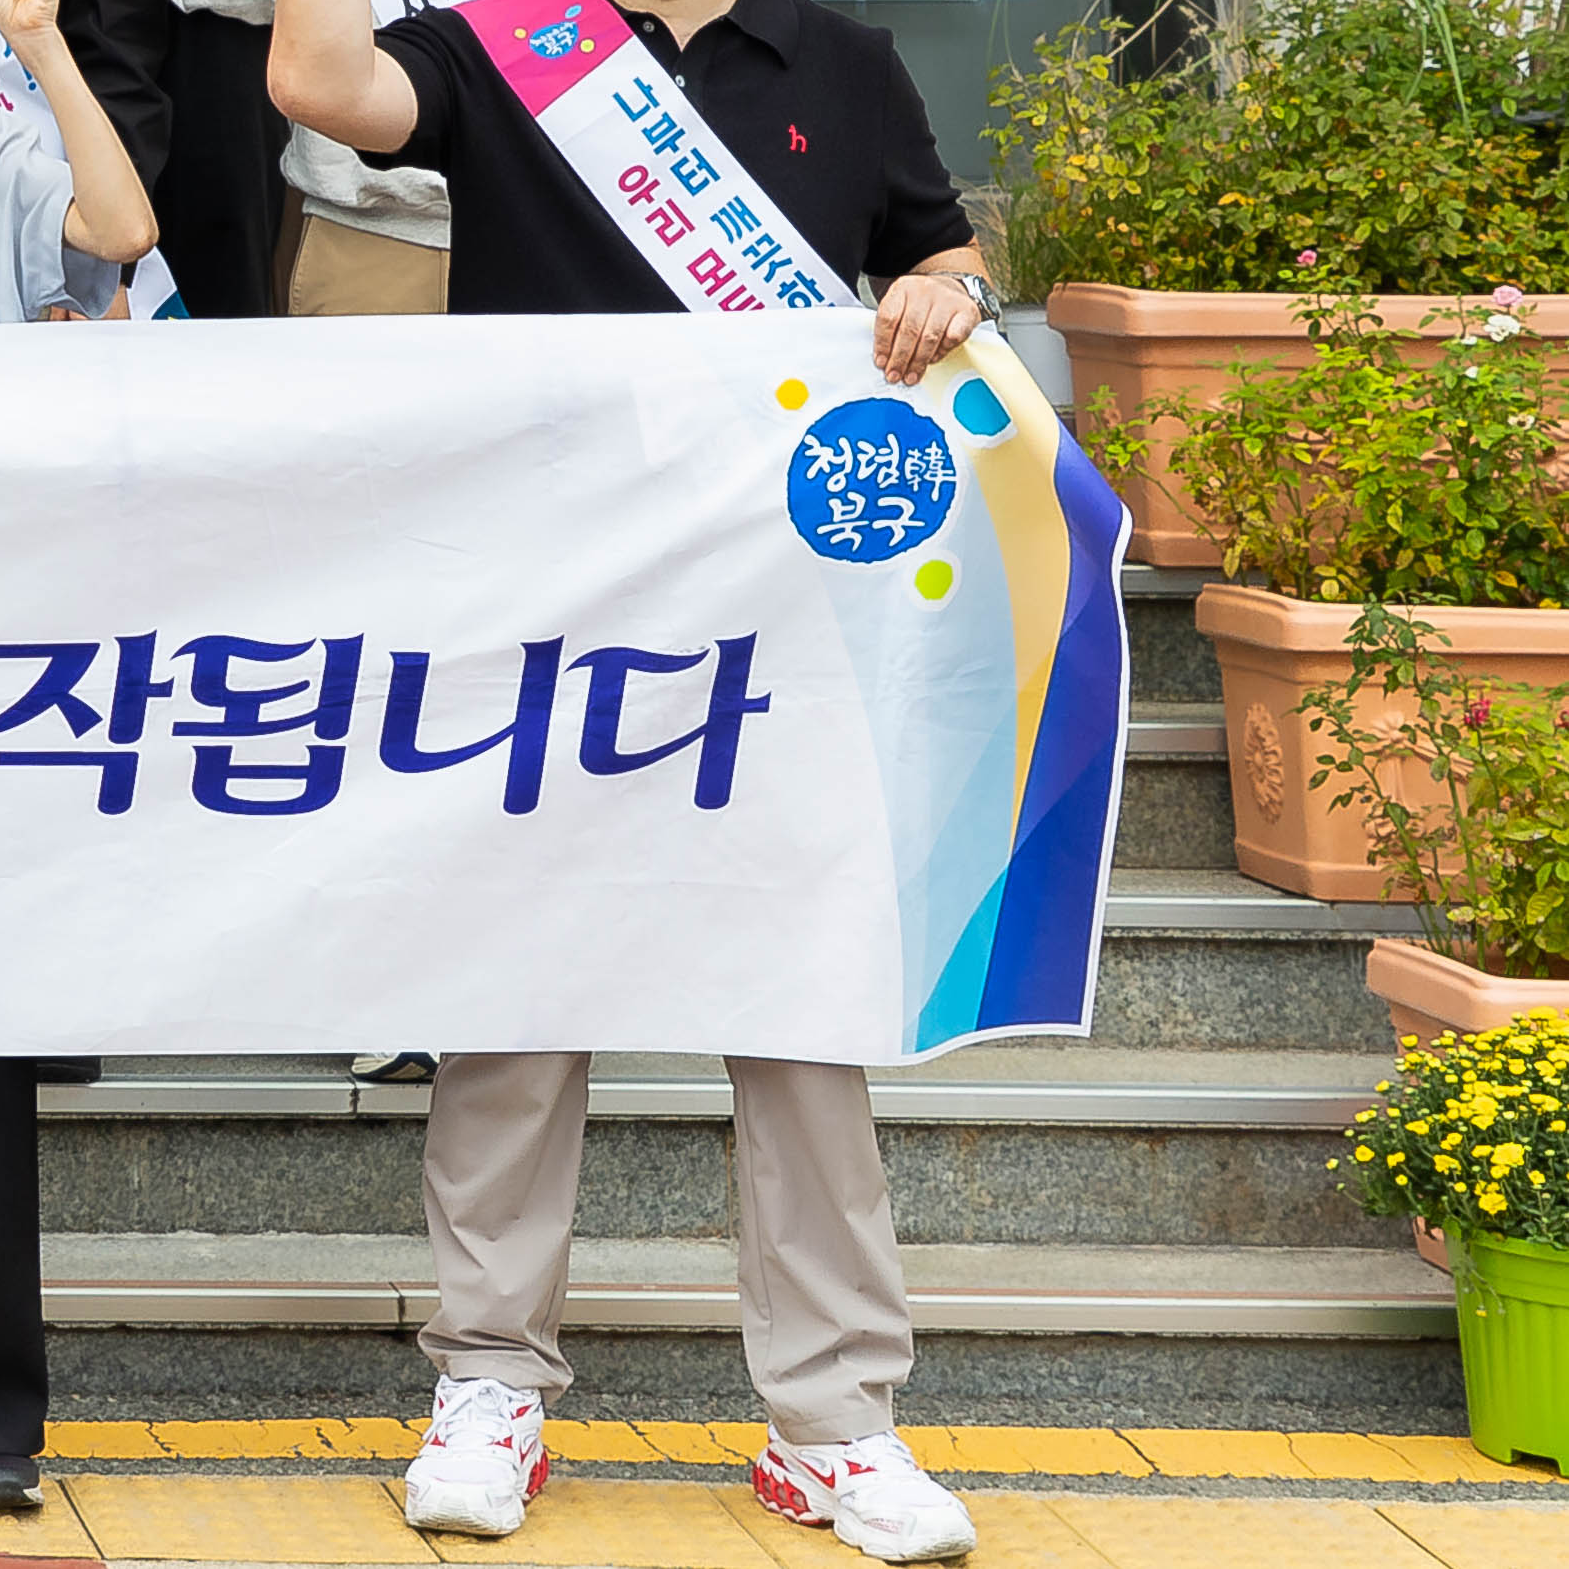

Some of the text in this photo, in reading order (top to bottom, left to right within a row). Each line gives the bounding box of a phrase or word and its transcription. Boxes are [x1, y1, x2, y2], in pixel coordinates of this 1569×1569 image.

[612, 77, 720, 196] 나부터
[618, 165, 695, 247] 우리
[817, 491, 925, 551] 북구
